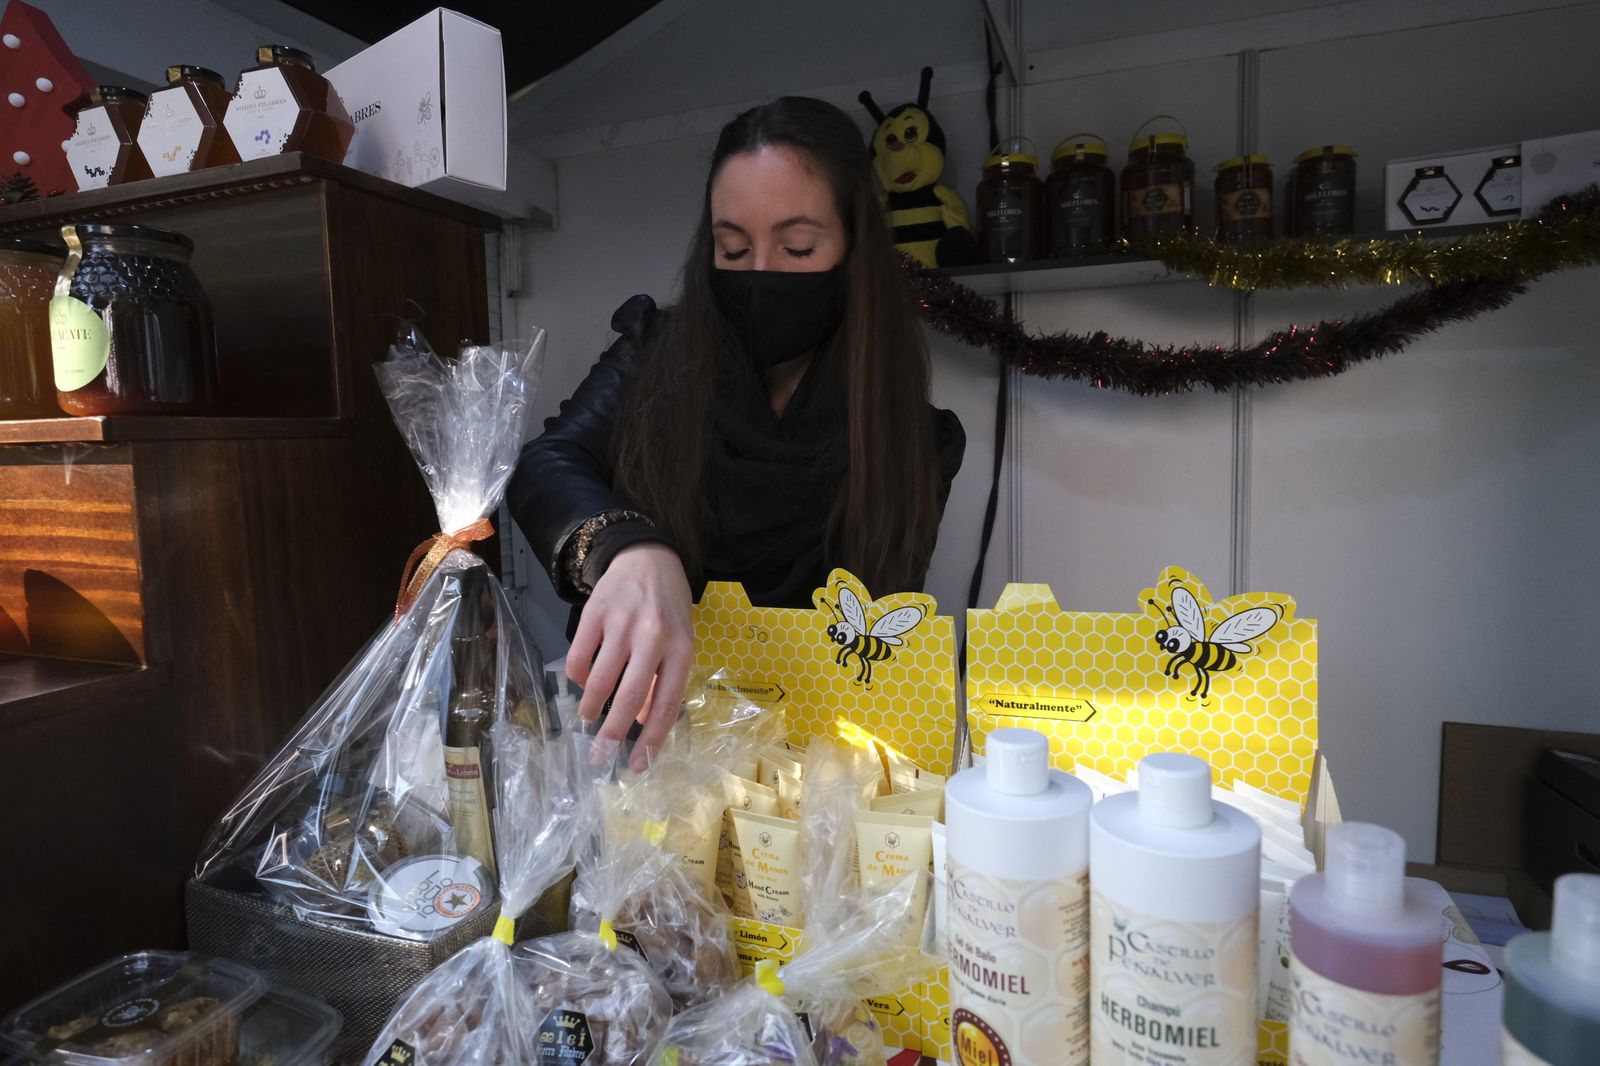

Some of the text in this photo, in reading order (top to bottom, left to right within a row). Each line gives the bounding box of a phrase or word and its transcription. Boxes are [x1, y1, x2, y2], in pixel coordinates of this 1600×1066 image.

[989, 699, 1082, 713] “Naturalmente”
[682, 855, 705, 865] Cream
[752, 848, 780, 861] Crema
[875, 850, 910, 862] Crema
[757, 862, 789, 875] Manos
[866, 864, 906, 876] de Man
[748, 880, 789, 896] Hand Cream
[740, 930, 768, 943] Limón
[867, 999, 890, 1009] Vera
[1101, 992, 1220, 1048] HERBOMIEL
[960, 1032, 993, 1066] Miel
